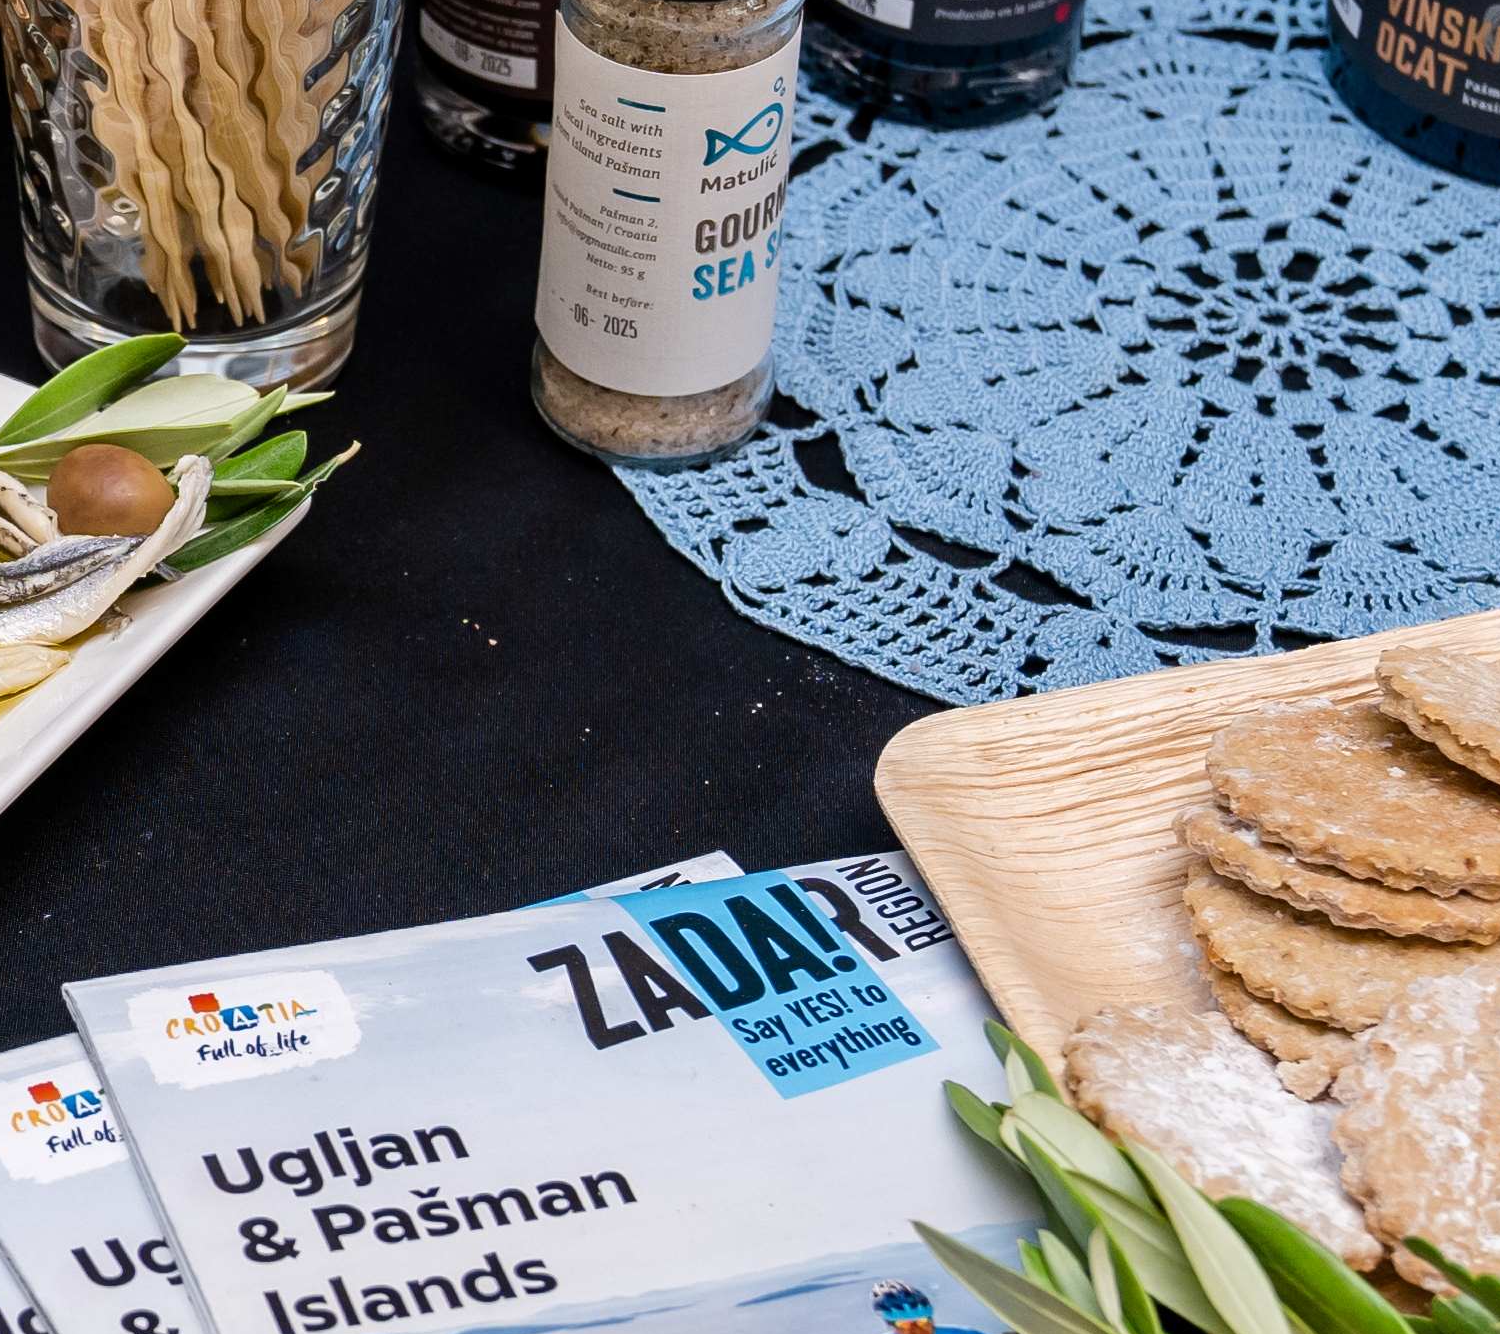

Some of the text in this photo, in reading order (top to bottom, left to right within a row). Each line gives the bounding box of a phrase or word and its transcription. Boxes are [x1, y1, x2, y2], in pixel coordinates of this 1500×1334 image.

[1375, 20, 1469, 97] OCAT
[579, 98, 664, 138] Sea salt with
[572, 135, 603, 166] island
[605, 156, 661, 181] Pašman
[586, 124, 663, 159] ingredients
[700, 148, 779, 195] Matulić
[600, 204, 645, 227] Pašman
[614, 225, 658, 244] Croatia
[620, 261, 635, 276] 95
[637, 268, 646, 281] g
[692, 250, 756, 301] SEA
[586, 282, 655, 311] Best before:
[603, 314, 639, 340] 2025
[835, 856, 955, 953] REGION
[165, 999, 318, 1041] CROATIA
[731, 981, 888, 1046] Say YES! to
[197, 1040, 242, 1066] Full
[765, 1014, 923, 1078] everything
[47, 1126, 92, 1155] Full
[201, 1124, 471, 1198] Ugljan
[237, 1216, 301, 1264] &
[311, 1169, 638, 1252] Pašman
